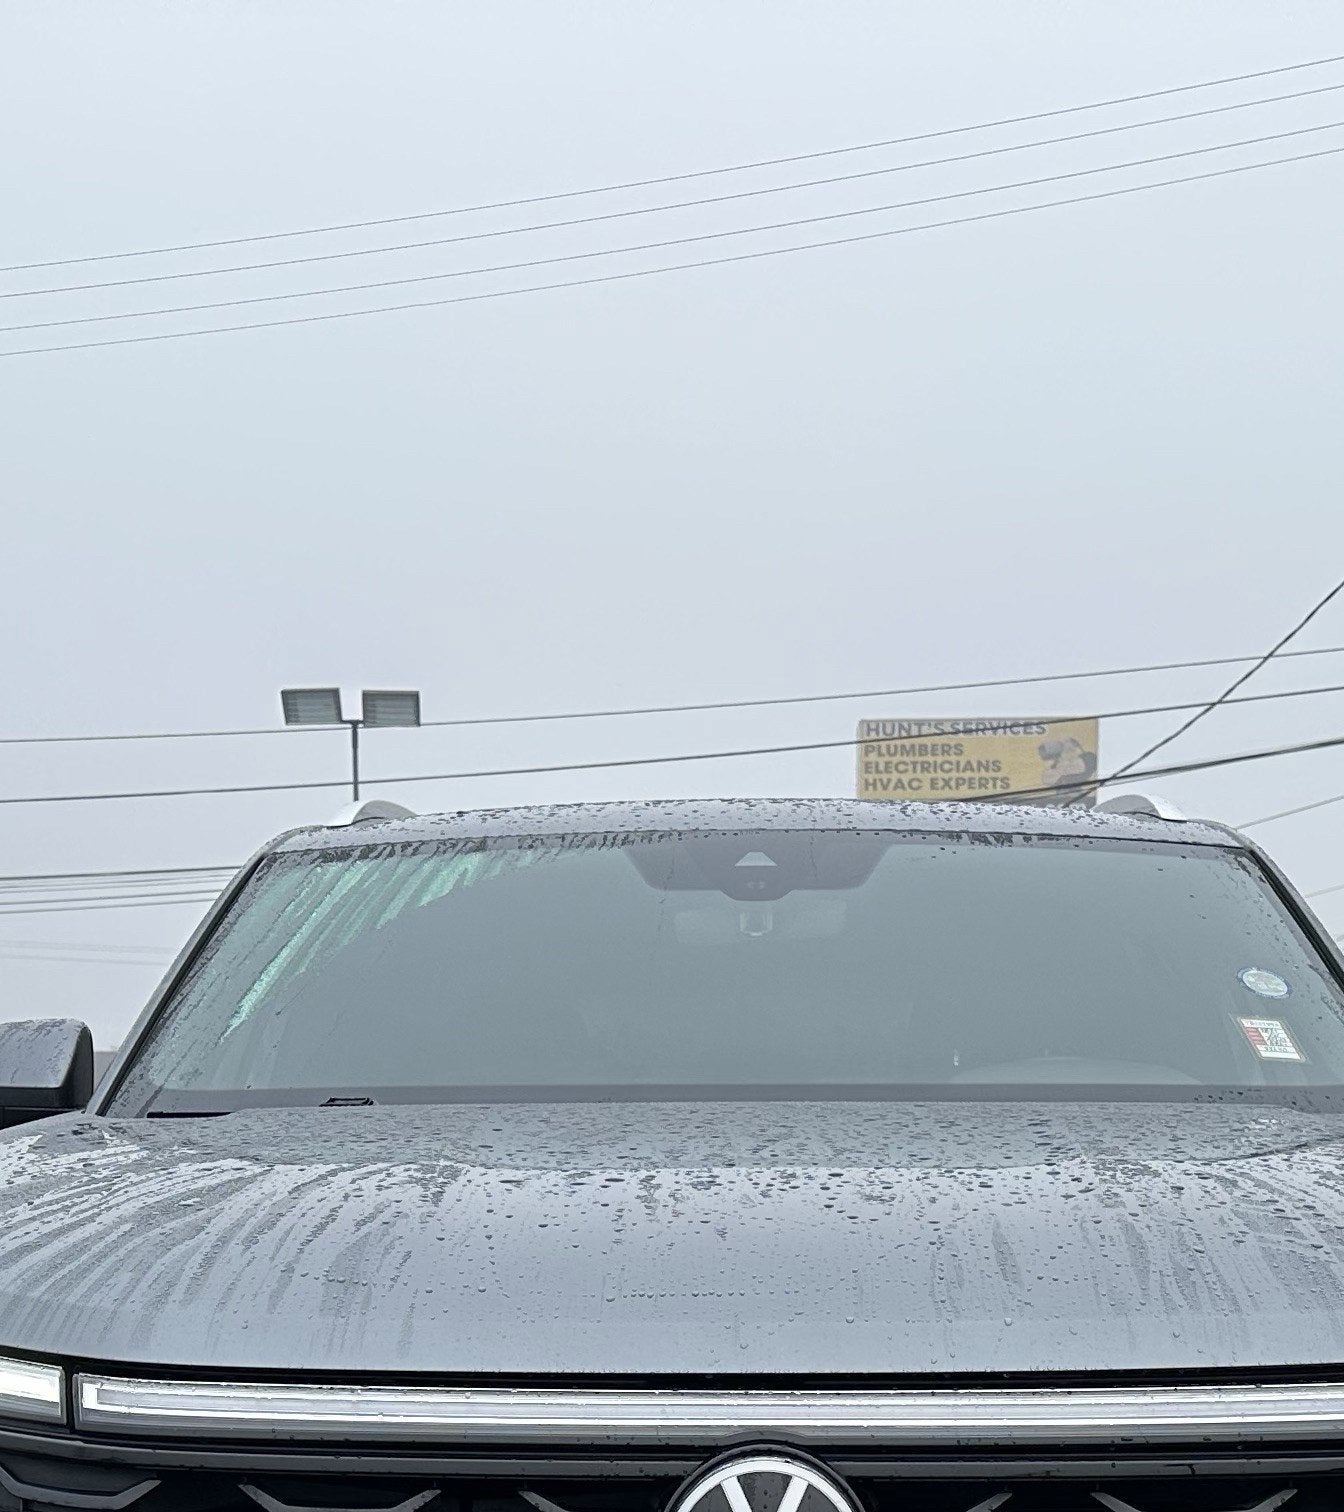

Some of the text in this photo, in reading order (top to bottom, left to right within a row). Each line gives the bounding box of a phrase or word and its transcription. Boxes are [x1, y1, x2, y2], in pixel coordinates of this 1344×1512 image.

[865, 720, 1047, 737] HUNT'S SERVICES
[864, 743, 964, 758] PLUMBERS
[864, 759, 1002, 775] ELECTRICIANS
[864, 776, 1011, 792] HVAC EXPERTS
